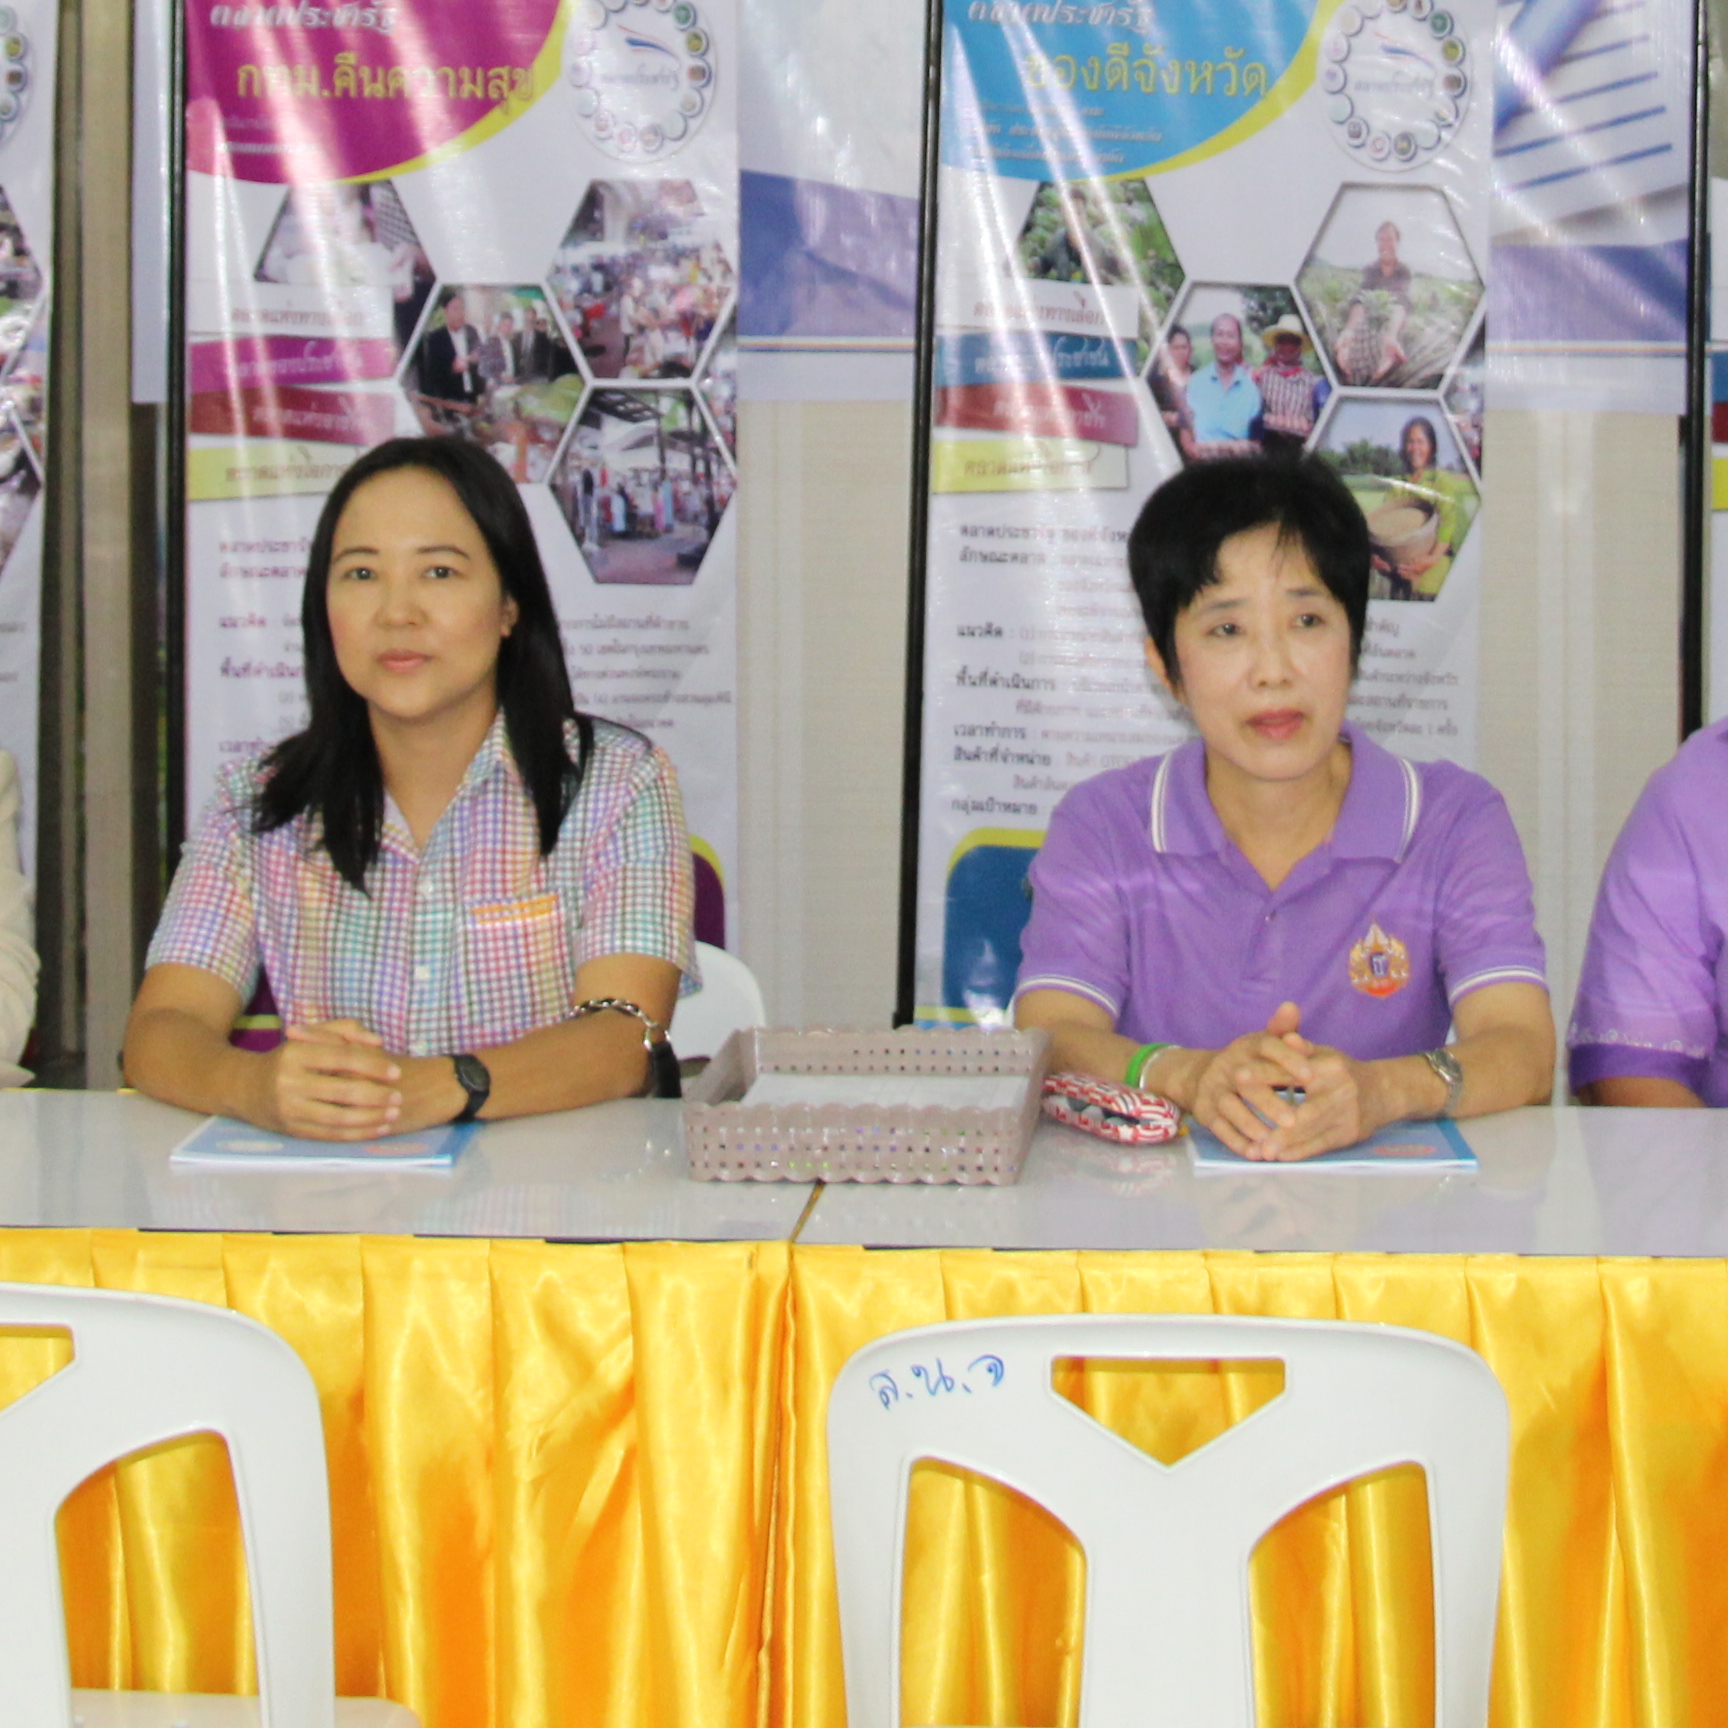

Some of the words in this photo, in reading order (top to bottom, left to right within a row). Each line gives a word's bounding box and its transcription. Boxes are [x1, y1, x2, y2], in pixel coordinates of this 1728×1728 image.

[1024, 42, 1270, 98] ของดีจังหวัด
